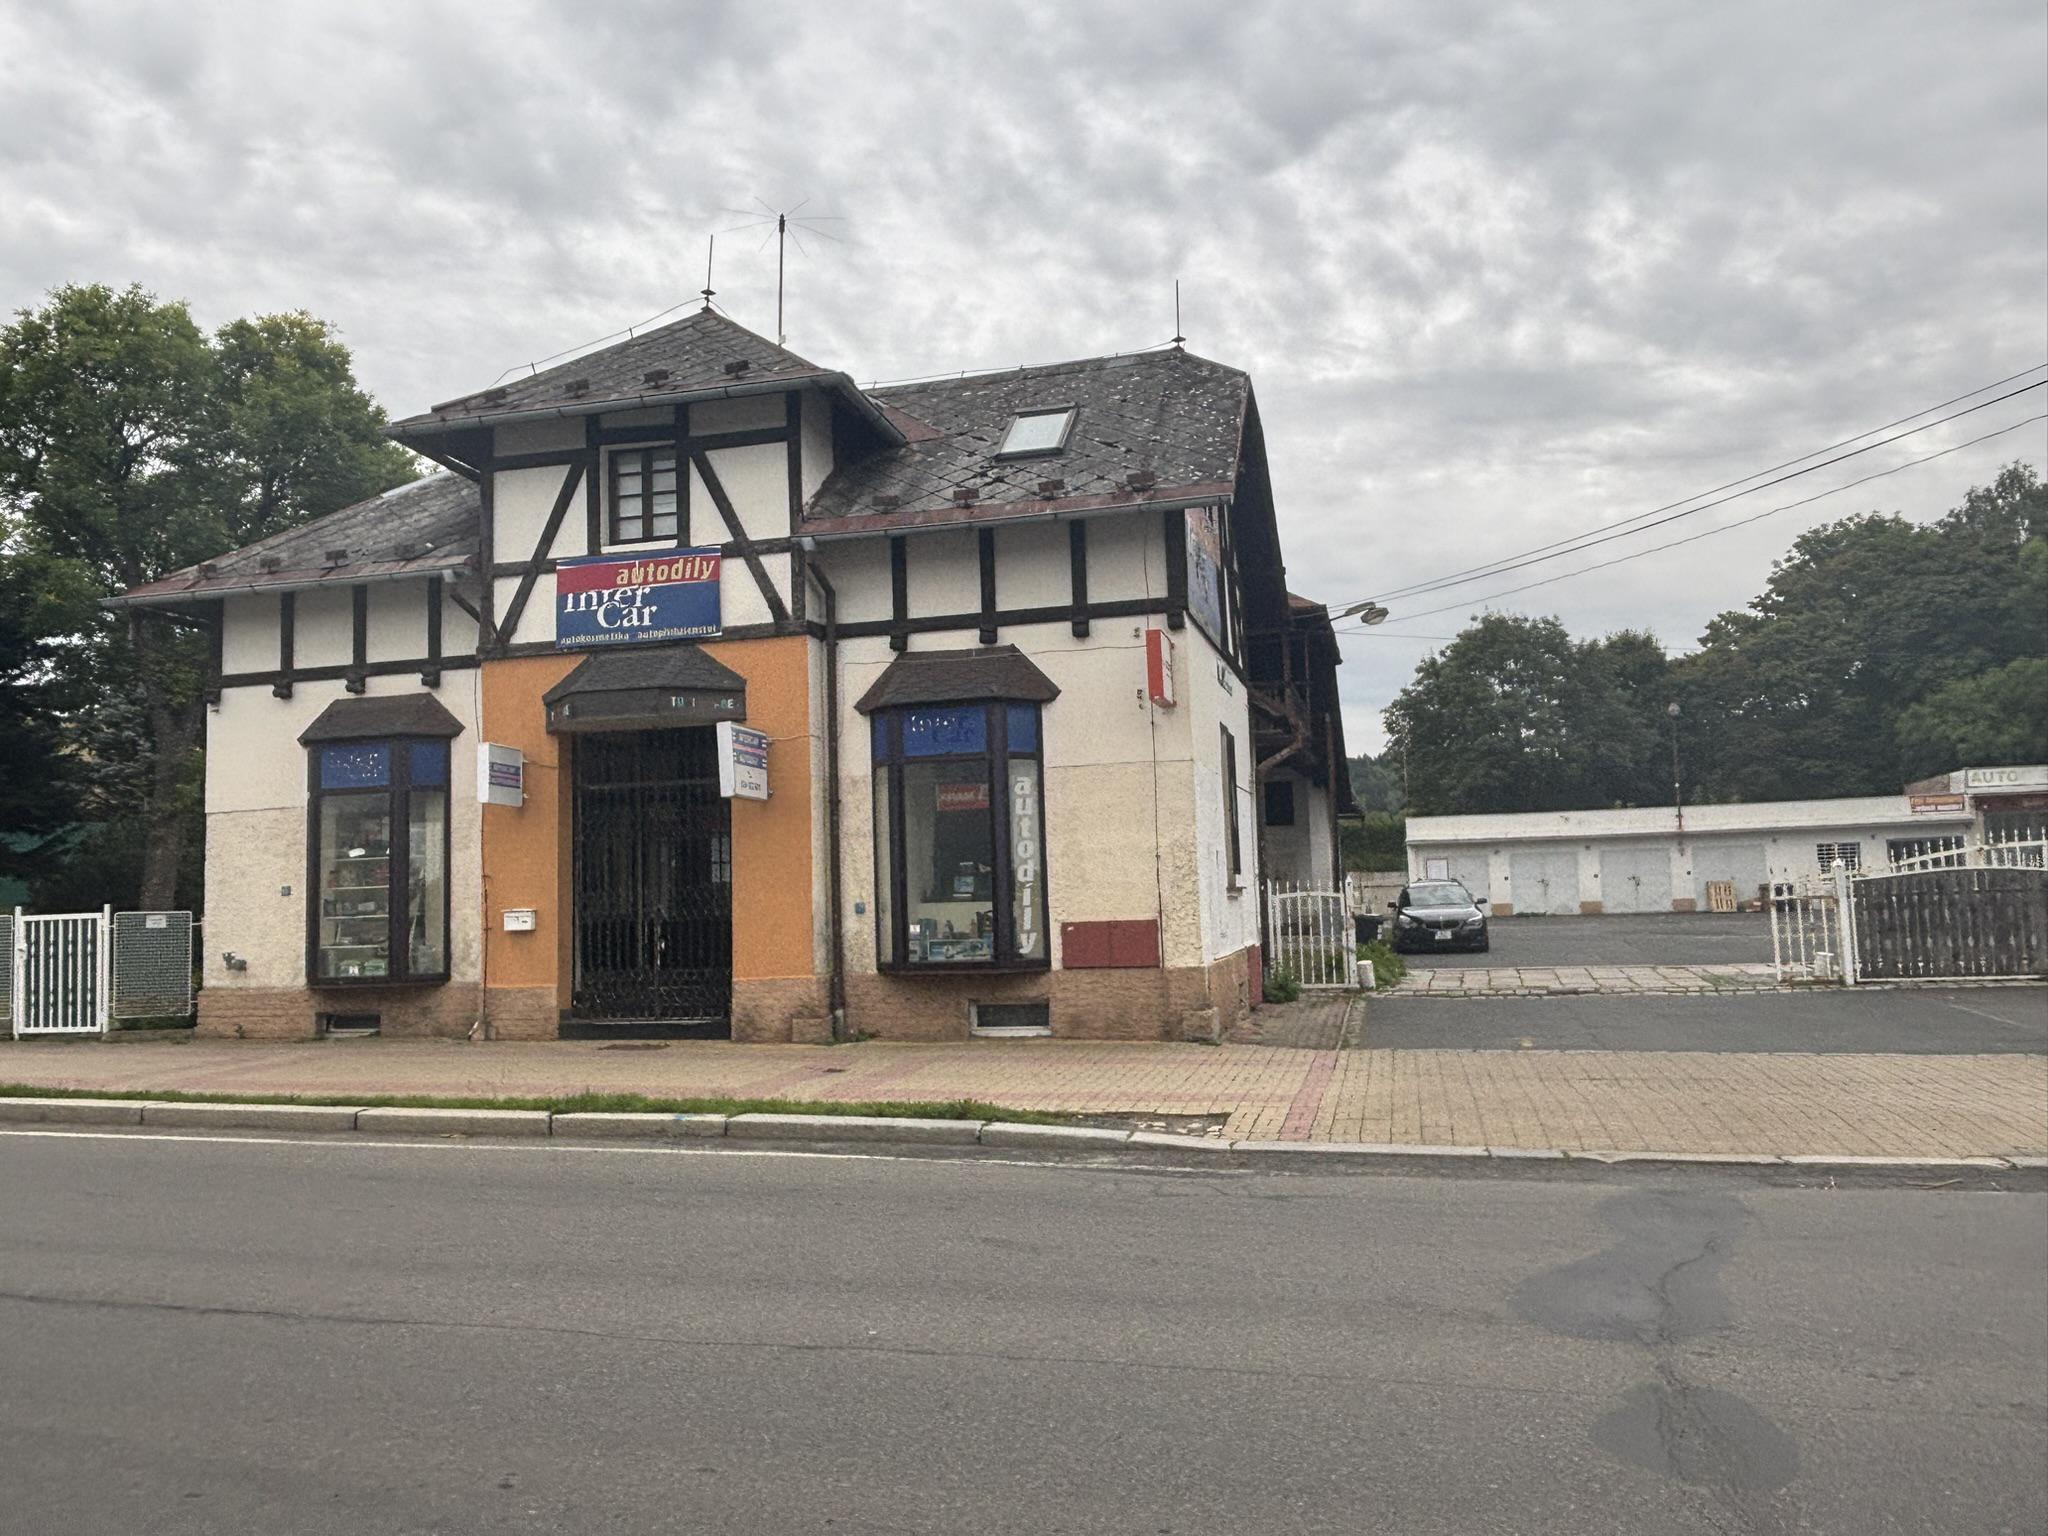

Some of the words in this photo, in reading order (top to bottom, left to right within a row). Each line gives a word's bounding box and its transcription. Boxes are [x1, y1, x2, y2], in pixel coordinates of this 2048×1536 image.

[596, 601, 658, 628] Car
[1971, 769, 2018, 784] AUTO
[1013, 776, 1038, 955] autodíly
